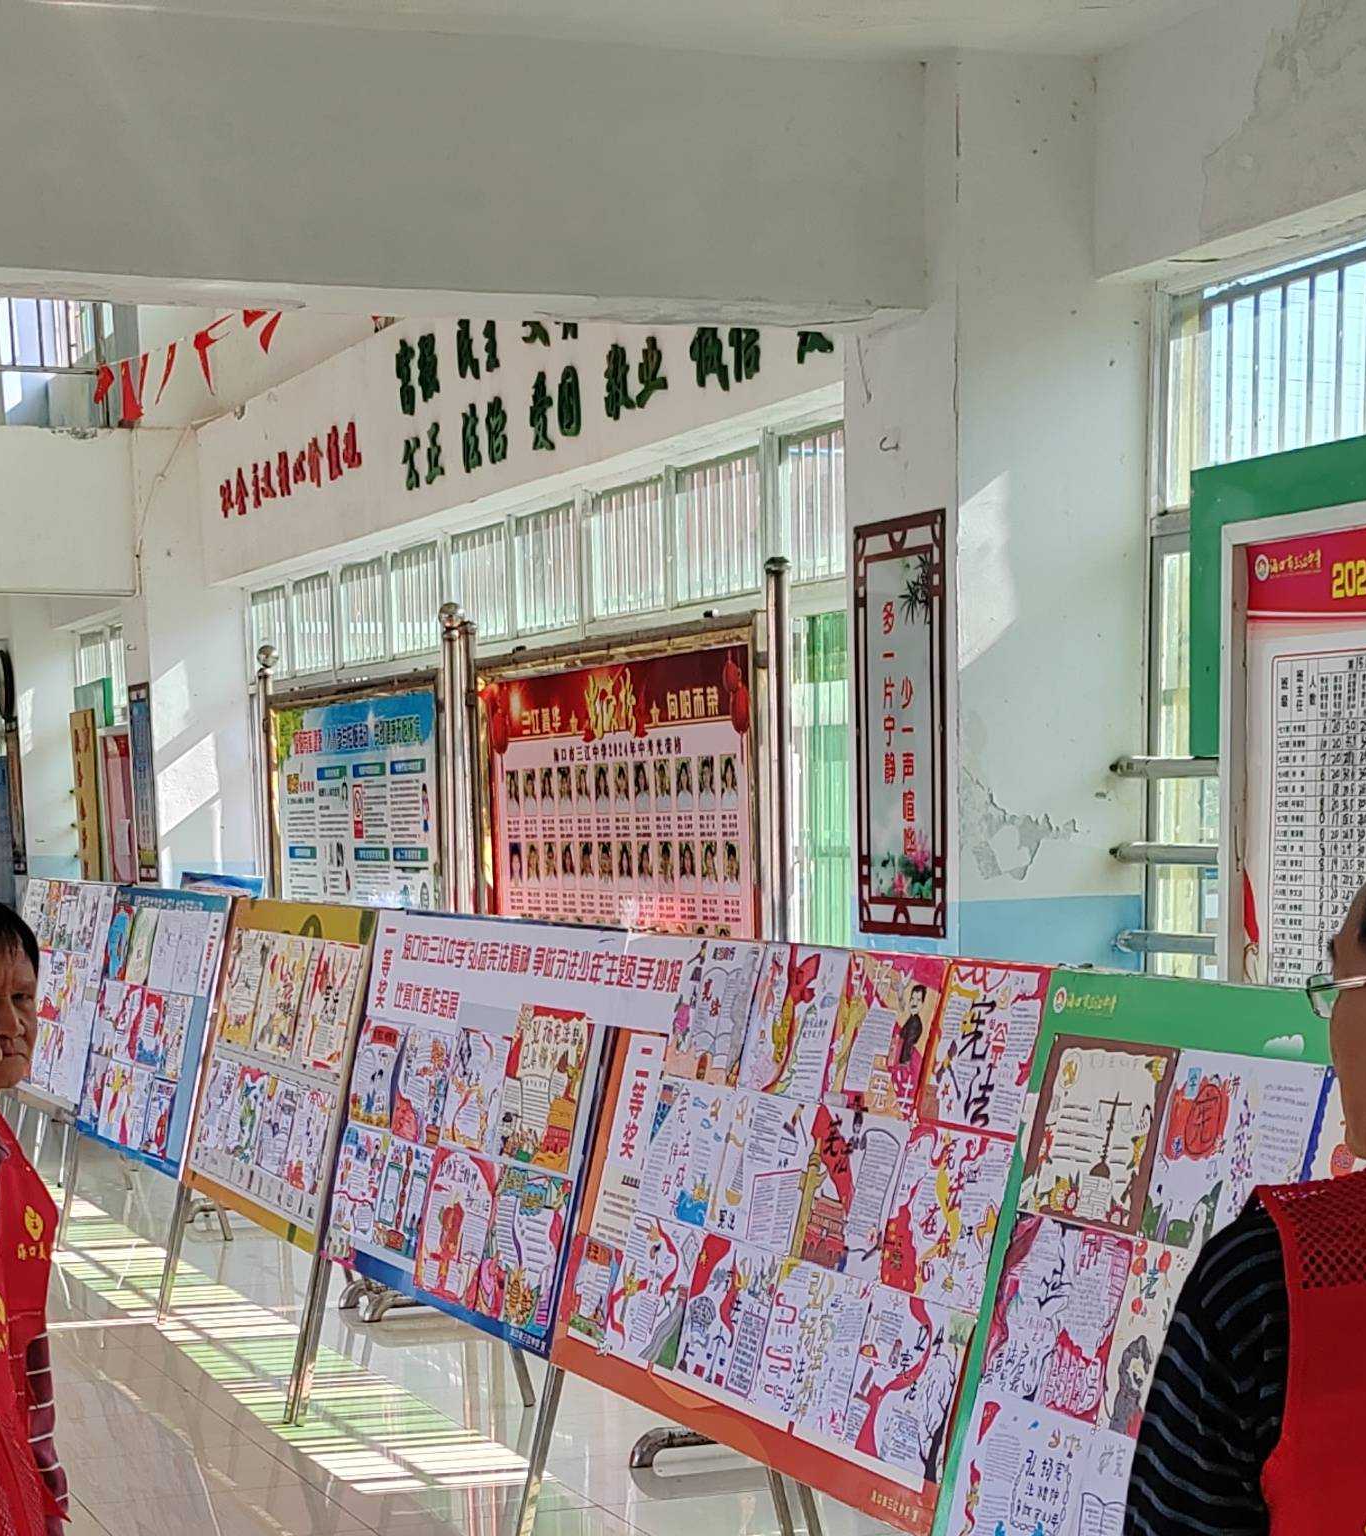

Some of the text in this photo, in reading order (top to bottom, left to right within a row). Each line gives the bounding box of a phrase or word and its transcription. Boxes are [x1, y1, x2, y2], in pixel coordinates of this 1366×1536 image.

[402, 422, 445, 491] 公正
[462, 396, 508, 473] 法治
[530, 365, 582, 450] 爱国
[604, 336, 668, 420] 敬业
[882, 601, 896, 785] 多一片宁静
